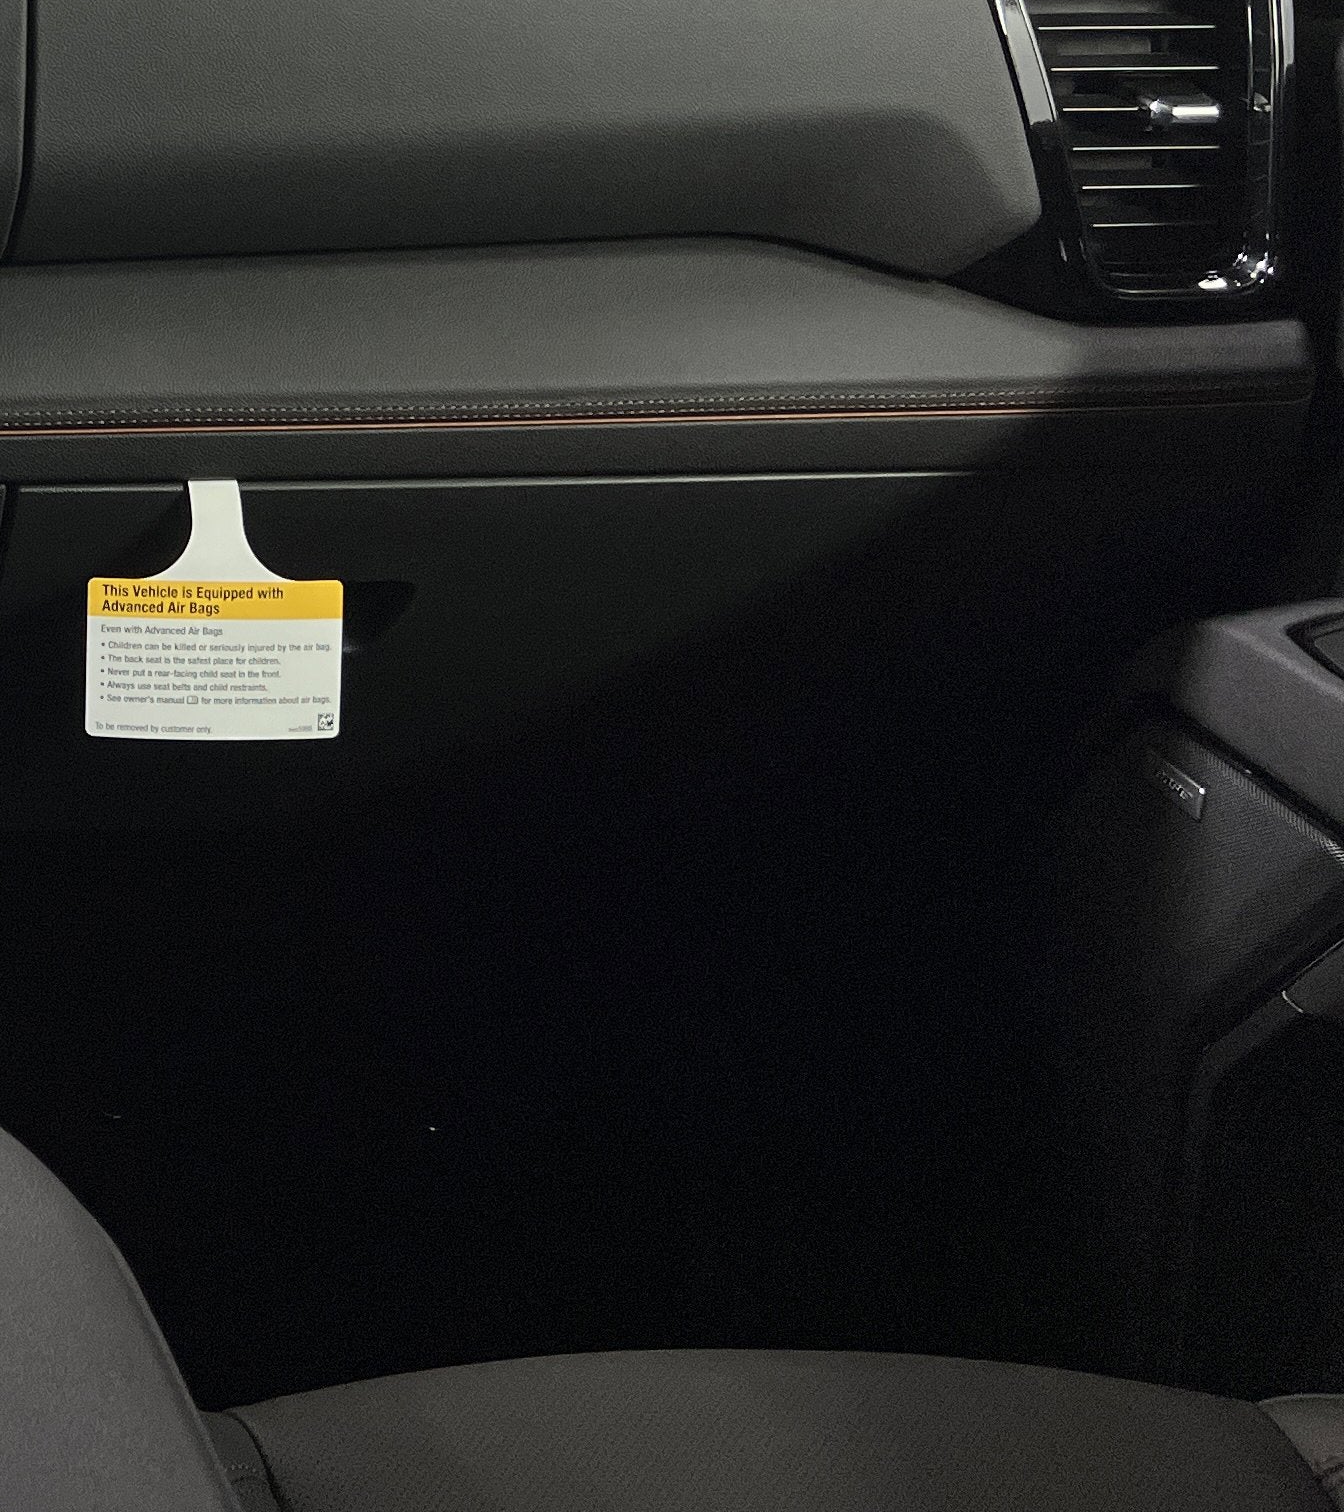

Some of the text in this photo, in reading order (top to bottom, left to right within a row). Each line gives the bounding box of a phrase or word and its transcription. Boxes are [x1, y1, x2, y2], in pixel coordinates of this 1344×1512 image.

[102, 584, 284, 601] This Vehicle is Equipped with
[102, 599, 220, 617] Advanced Air Bags
[101, 624, 223, 637] Even with Advanced Air Bags
[108, 640, 142, 649] Children
[162, 642, 171, 650] be
[248, 643, 276, 653] injured
[277, 643, 286, 653] by
[289, 643, 301, 651] the
[108, 654, 122, 662] The
[124, 654, 143, 663] back
[173, 656, 185, 664] the
[213, 657, 233, 665] place
[107, 668, 129, 676] Never
[132, 669, 145, 677] put
[154, 669, 197, 678] rear-facing
[199, 670, 218, 678] child
[248, 670, 259, 678] the
[107, 680, 135, 690] Always
[107, 694, 121, 702] See
[123, 695, 154, 704] owner's
[156, 696, 184, 704] manual
[201, 696, 211, 704] for
[213, 697, 232, 705] more
[235, 696, 276, 705] information
[278, 696, 299, 704] about
[95, 721, 103, 729] To
[106, 722, 114, 730] be
[117, 723, 148, 732] removed
[150, 724, 158, 733] by
[161, 725, 194, 733] customer
